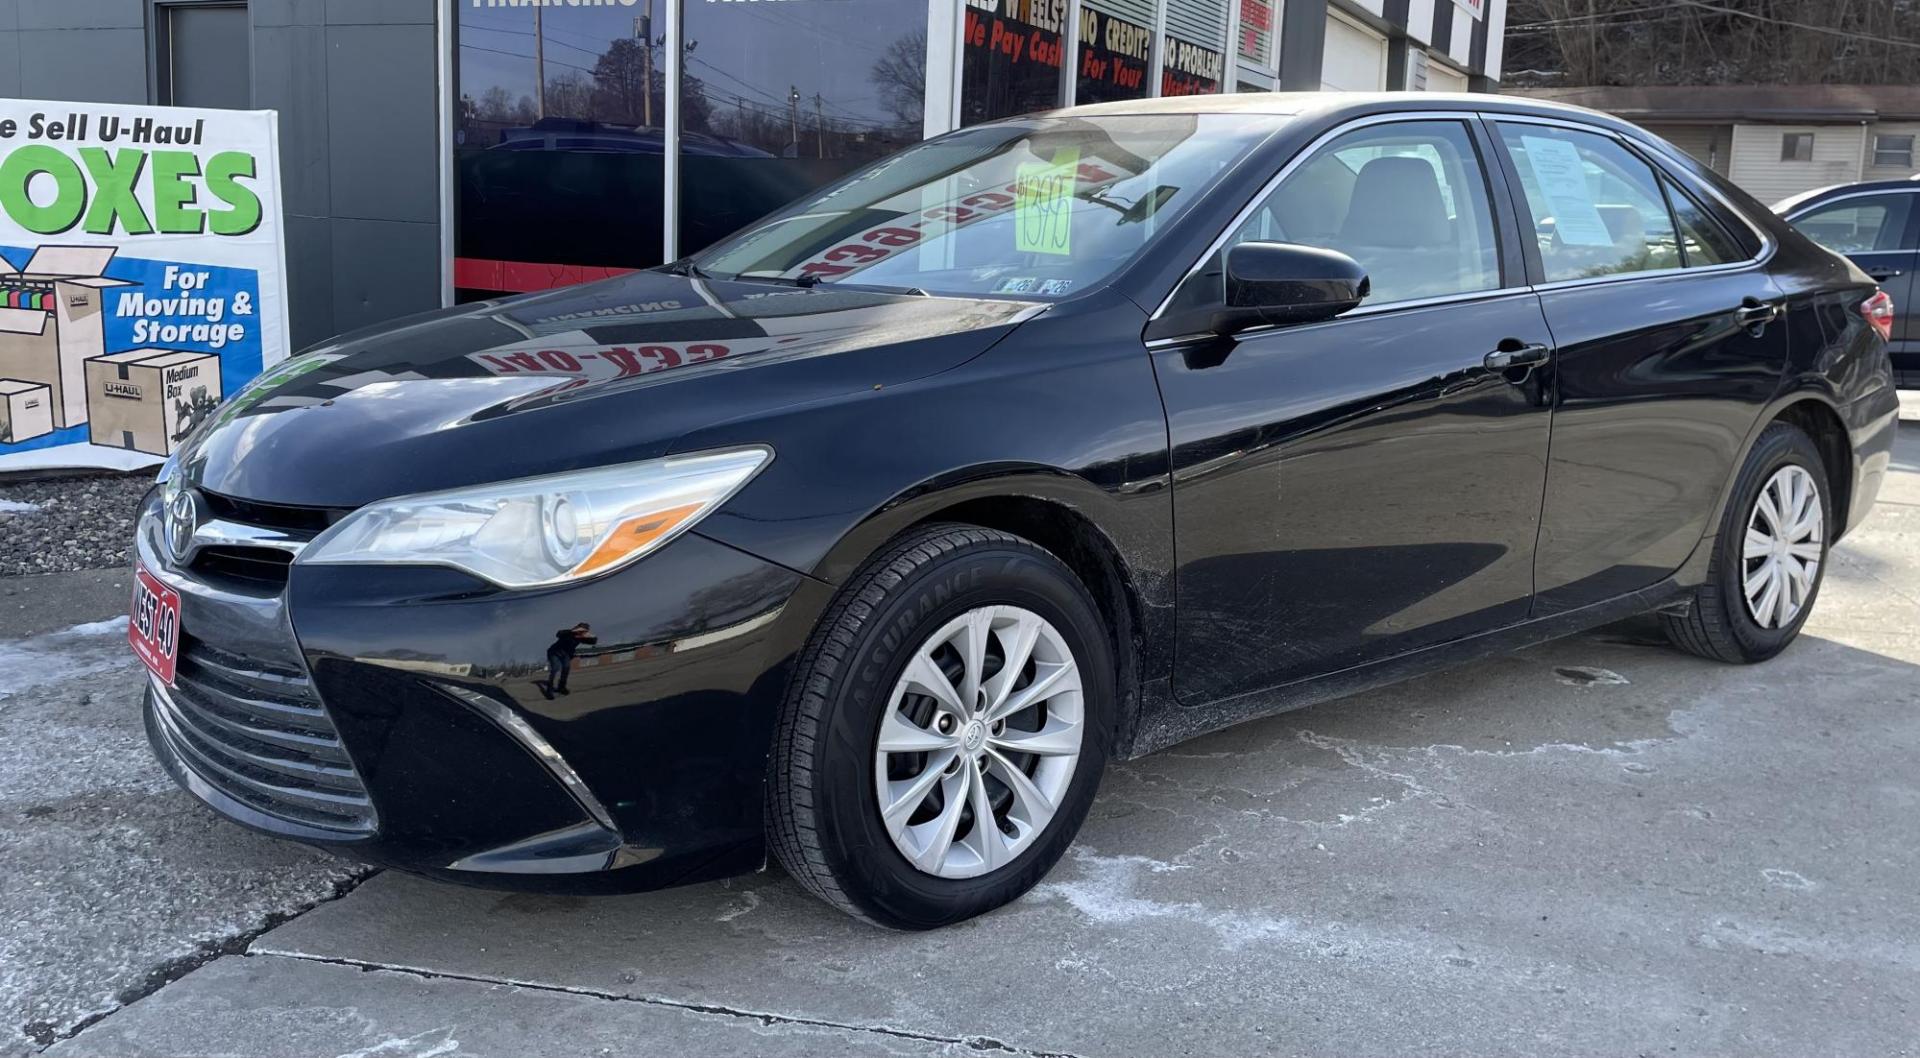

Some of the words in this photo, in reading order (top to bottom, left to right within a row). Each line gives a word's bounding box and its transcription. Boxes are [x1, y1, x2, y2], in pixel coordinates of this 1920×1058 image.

[965, 11, 986, 47] We
[990, 19, 1024, 63] Pay
[1029, 31, 1065, 68] Cash
[1080, 8, 1098, 46] NO
[1105, 17, 1150, 62] CREDIT?
[1083, 49, 1107, 80] For
[1113, 57, 1143, 89] Your
[1178, 42, 1222, 82] PROBLEM!
[0, 118, 17, 138] e
[28, 112, 88, 141] Sell
[99, 115, 204, 145] U-Haul
[0, 144, 263, 236] OXES
[163, 265, 210, 290] For
[116, 290, 225, 323] Moving
[231, 291, 253, 315] &
[132, 319, 245, 348] Storage
[105, 383, 140, 396] U-HAUL
[166, 366, 199, 385] Medium
[167, 384, 183, 400] Box
[132, 575, 159, 646] WEST
[157, 601, 176, 660] 40
[853, 566, 983, 707] ASSURANCE
